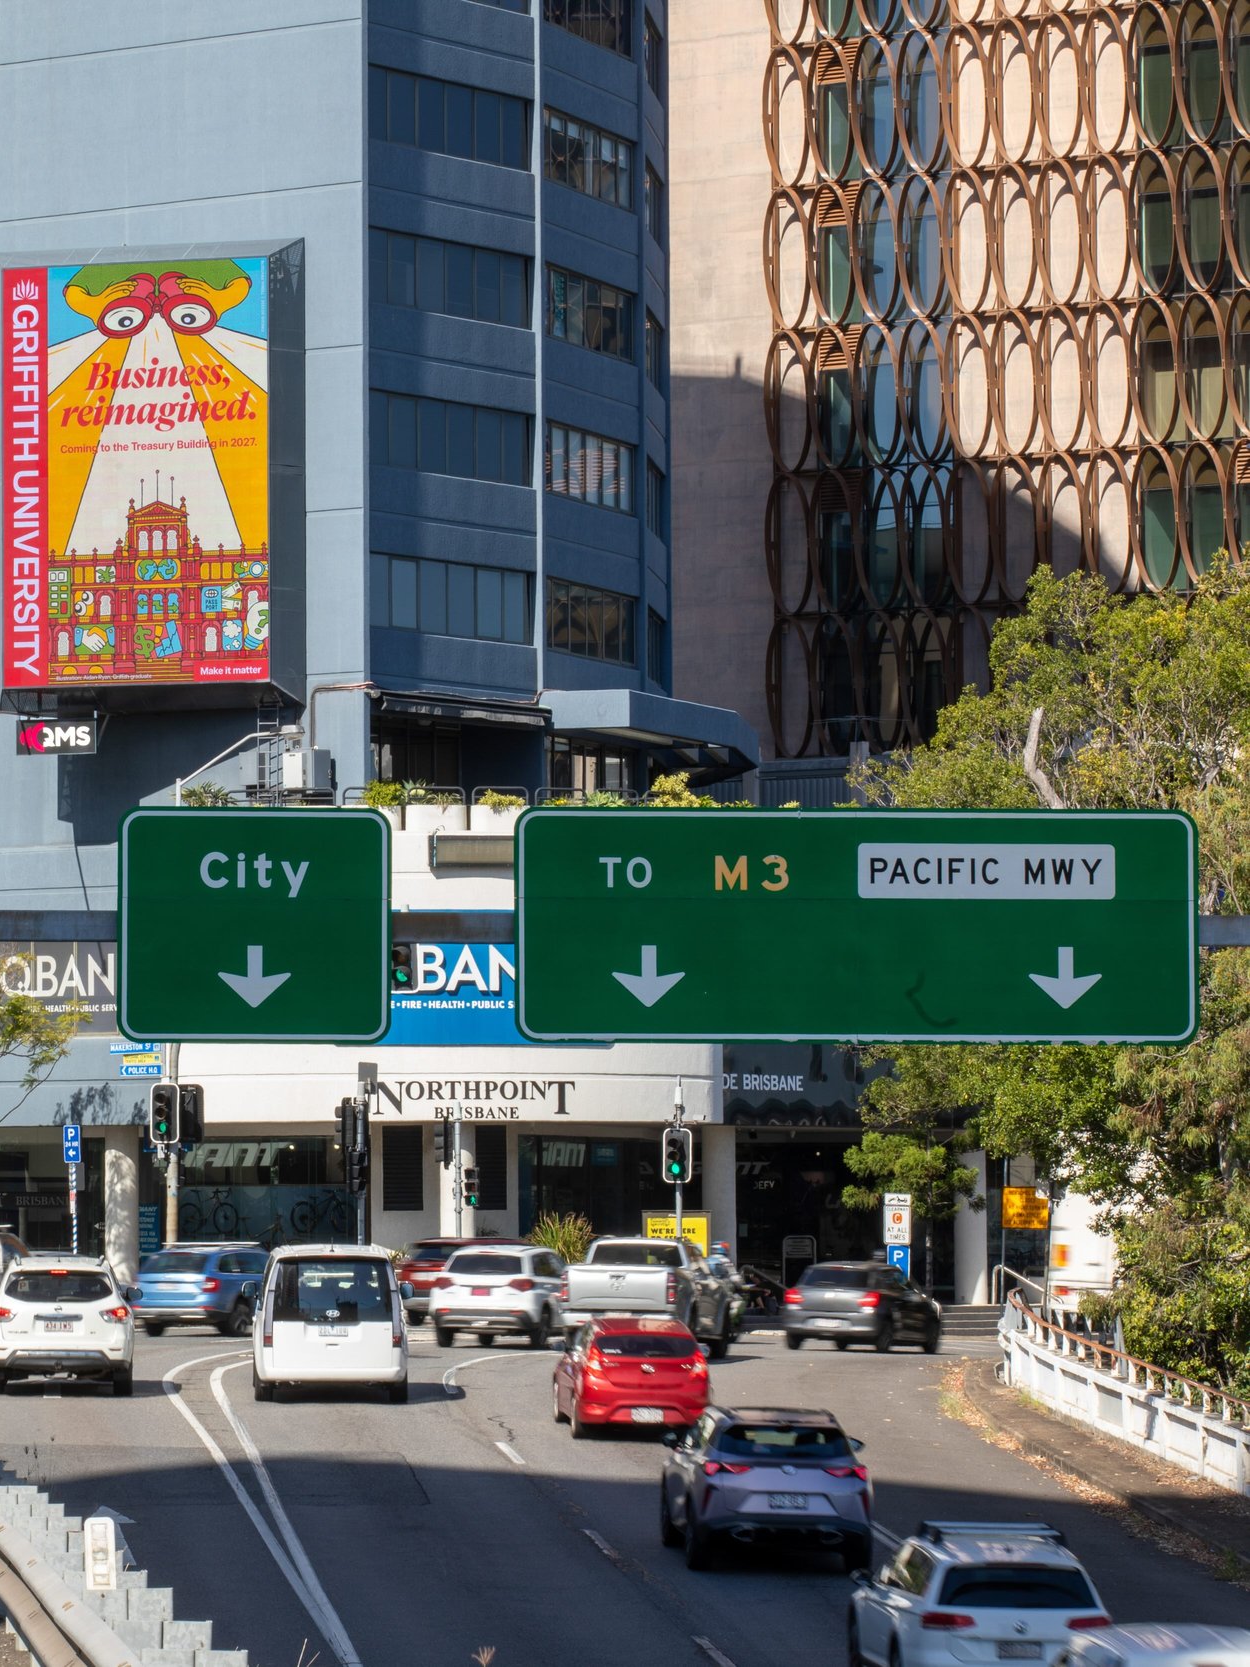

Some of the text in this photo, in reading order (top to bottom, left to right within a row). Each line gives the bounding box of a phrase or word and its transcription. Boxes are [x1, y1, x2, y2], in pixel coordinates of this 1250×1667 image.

[85, 357, 230, 392] Business,
[60, 391, 257, 431] reimagined.
[60, 437, 258, 456] Coming to the Treasury Building in 2027.
[12, 304, 40, 677] GRIFFITH UNIVERSITY
[200, 665, 262, 676] Make it matter
[33, 721, 91, 753] QMS
[199, 851, 310, 898] City
[599, 856, 653, 889] TO
[869, 857, 1000, 885] PACIFIC
[1024, 858, 1103, 885] MWY
[45, 1004, 71, 1013] HEALTH
[401, 1000, 422, 1009] FIRE
[428, 1000, 465, 1009] HEALTH
[471, 1000, 505, 1009] PUBLIC
[128, 1066, 147, 1074] POLICE
[742, 1073, 804, 1092] BRISBANE
[372, 1080, 576, 1115] NORTHPOINT
[434, 1107, 520, 1119] BRSBANE
[67, 1127, 75, 1141] P
[651, 1227, 696, 1235] WE'RE ERE
[893, 1250, 904, 1262] P
